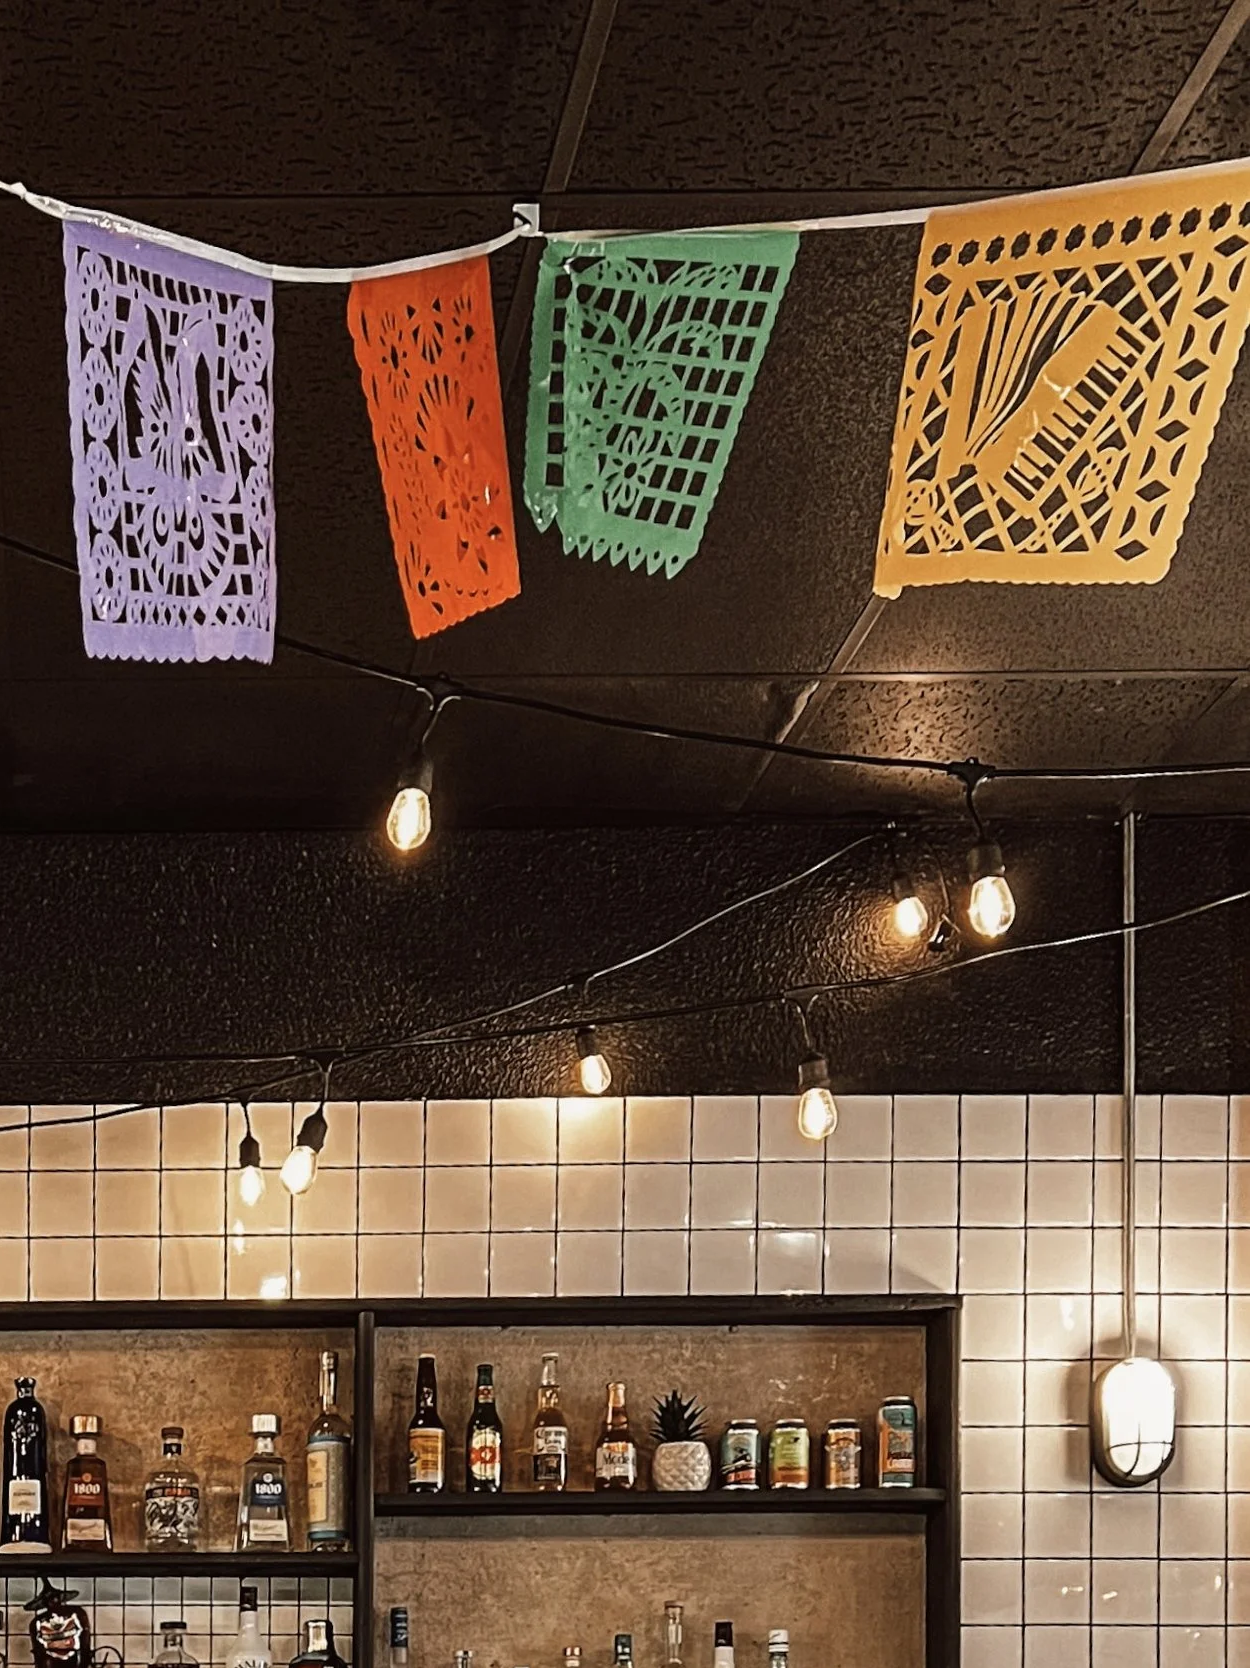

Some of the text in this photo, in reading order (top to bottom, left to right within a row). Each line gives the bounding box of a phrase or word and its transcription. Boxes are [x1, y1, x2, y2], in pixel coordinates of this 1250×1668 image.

[604, 1452, 637, 1465] Mode
[74, 1483, 101, 1495] 1800
[255, 1483, 282, 1495] 1800
